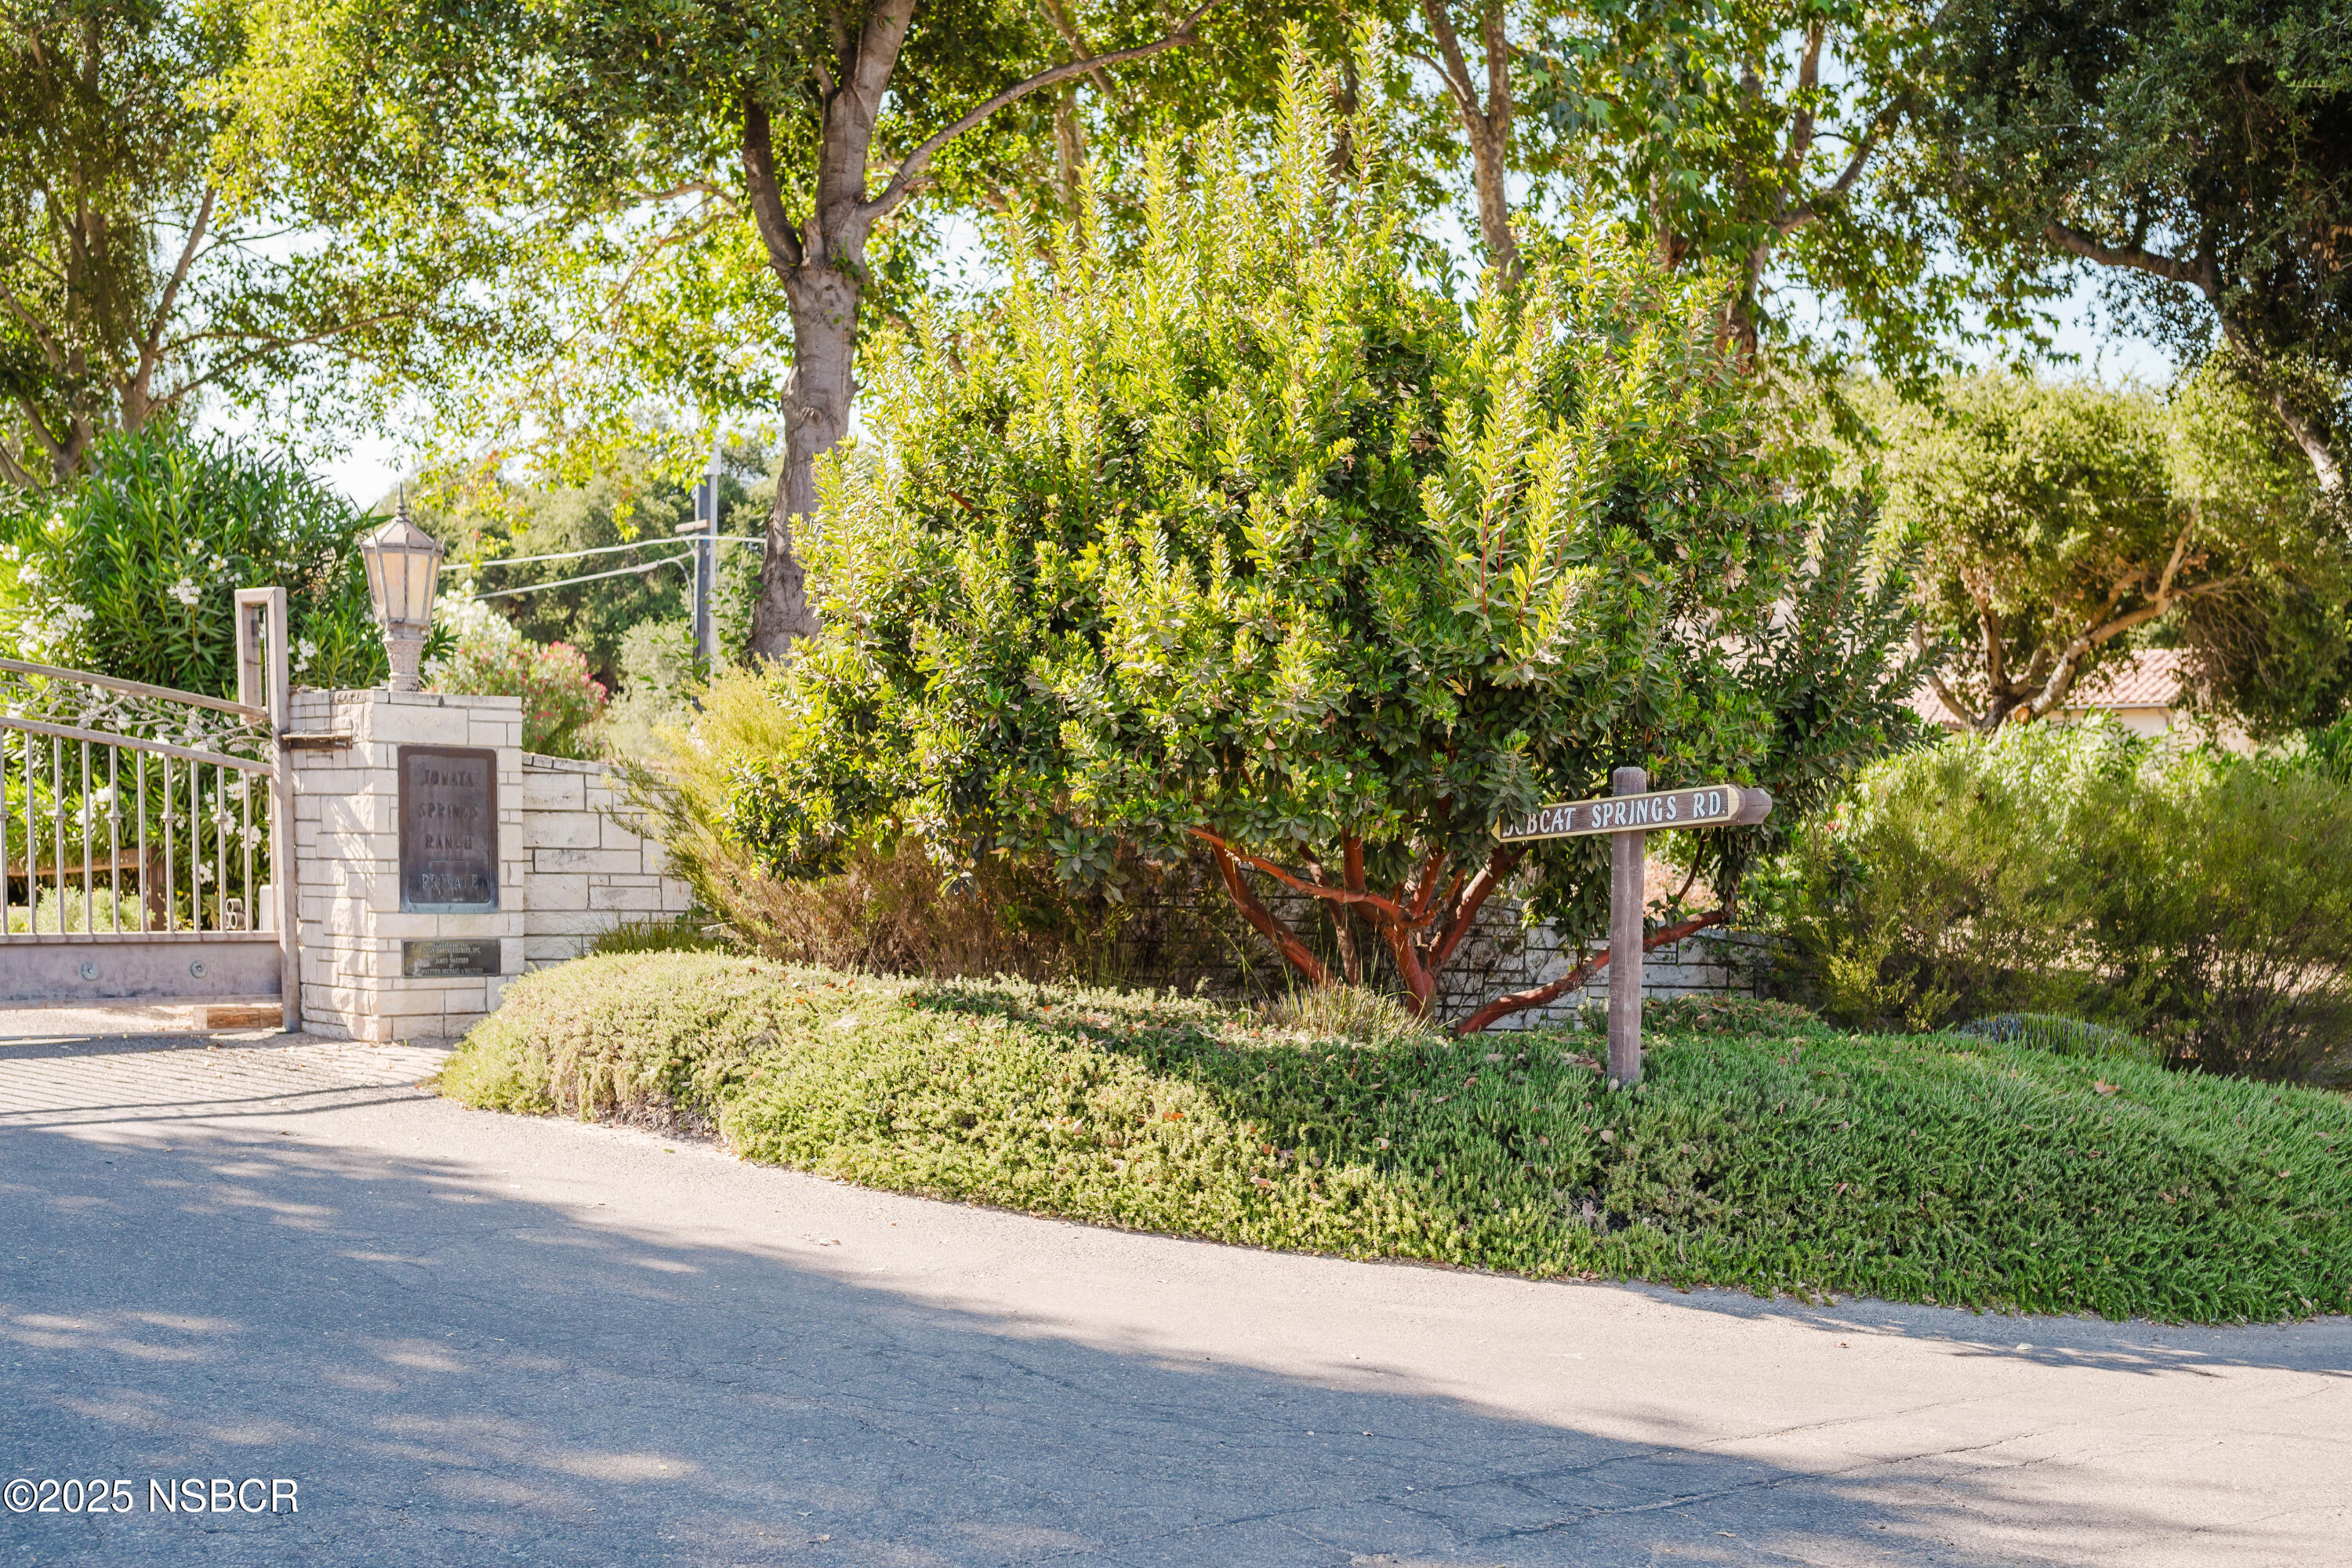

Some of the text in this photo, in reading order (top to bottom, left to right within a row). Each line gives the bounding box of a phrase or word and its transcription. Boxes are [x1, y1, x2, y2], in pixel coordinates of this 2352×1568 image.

[421, 769, 474, 787] JONATA
[418, 802, 479, 818] SPRINGS
[1591, 795, 1677, 829] SPRINGS
[1693, 790, 1726, 818] RD.
[425, 833, 474, 850] RANCH
[421, 873, 479, 891] PRIVATE
